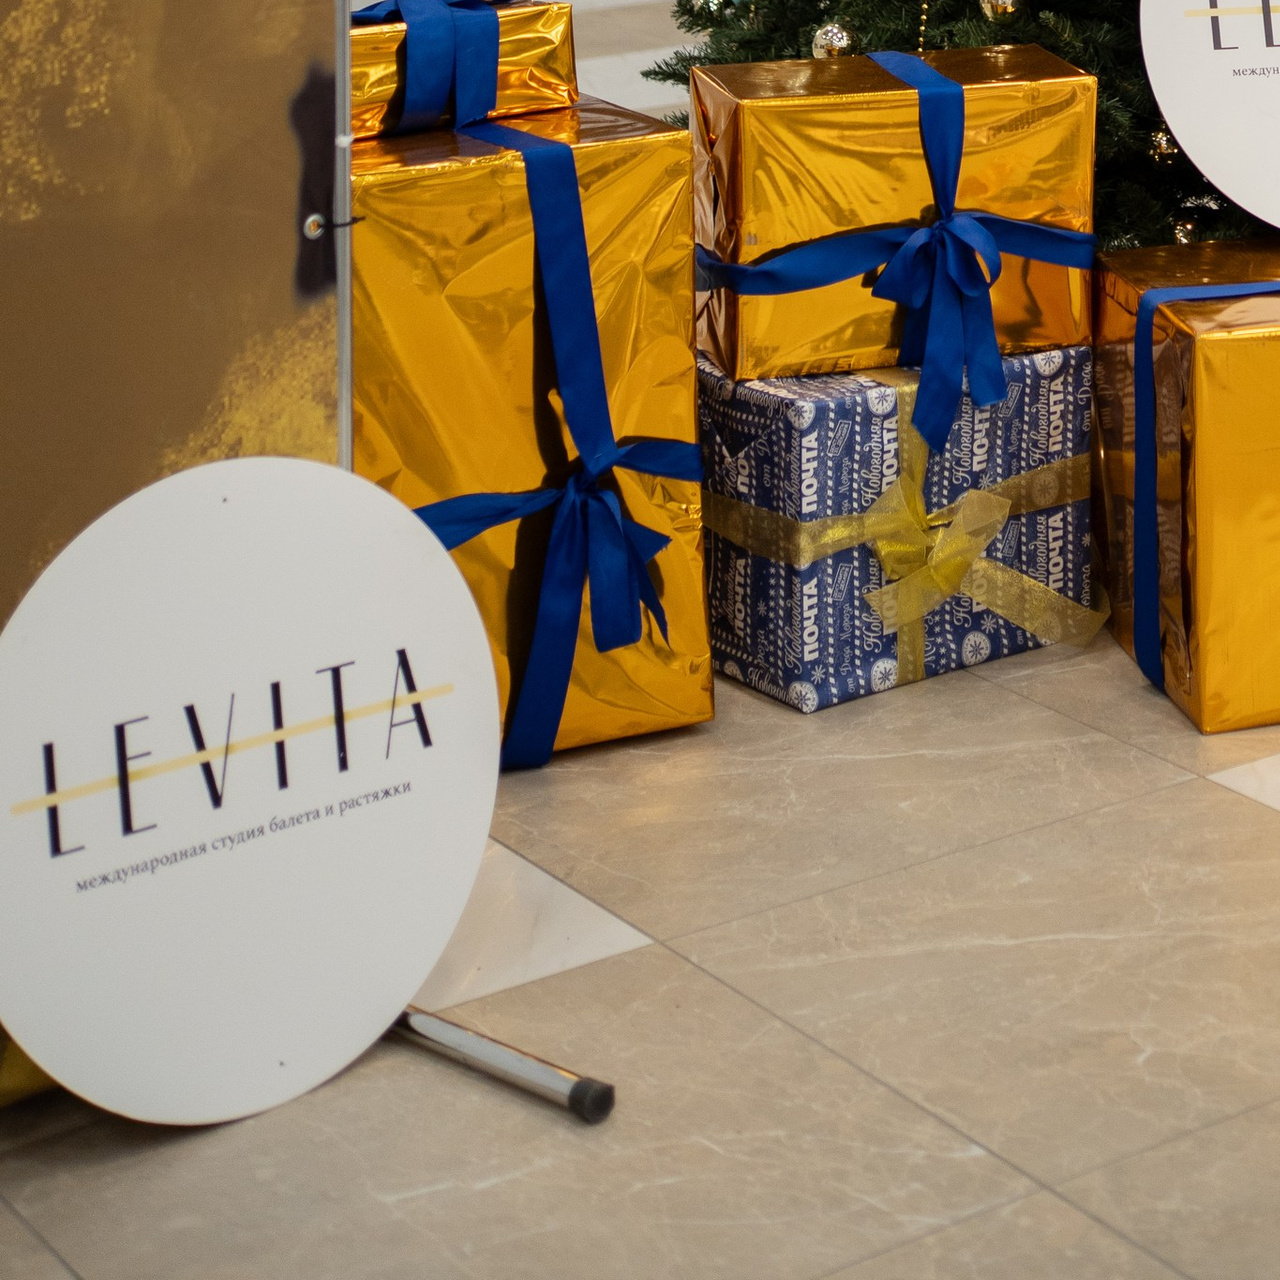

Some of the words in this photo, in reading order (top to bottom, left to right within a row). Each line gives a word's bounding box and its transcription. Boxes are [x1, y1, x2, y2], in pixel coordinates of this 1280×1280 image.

[952, 397, 973, 487] Новогодняя
[973, 405, 991, 472] ПОЧТ
[1008, 418, 1022, 454] Мороза
[1030, 378, 1050, 466] Новогодняя
[1048, 374, 1065, 453] ПОЧТА
[785, 429, 800, 523] Новогодняя
[801, 428, 818, 514] ПОЧТА
[838, 457, 852, 495] Мороза
[861, 416, 882, 507] Новогодняя
[723, 551, 737, 626] овогодняя
[1028, 514, 1047, 586] овогодняя
[1048, 511, 1064, 590] ПОЧТА
[735, 558, 746, 638] ПОЧТА
[784, 575, 803, 675] Новогодняя
[802, 577, 820, 662] ПОЧТА
[840, 603, 853, 642] Мороза
[756, 630, 769, 668] роза
[840, 646, 853, 676] Деда
[847, 678, 856, 693] от
[43, 648, 433, 859] LEVITA
[76, 842, 207, 893] международная
[211, 826, 265, 852] студия
[269, 808, 321, 833] балета
[324, 805, 334, 817] и
[338, 781, 412, 817] растяжки
